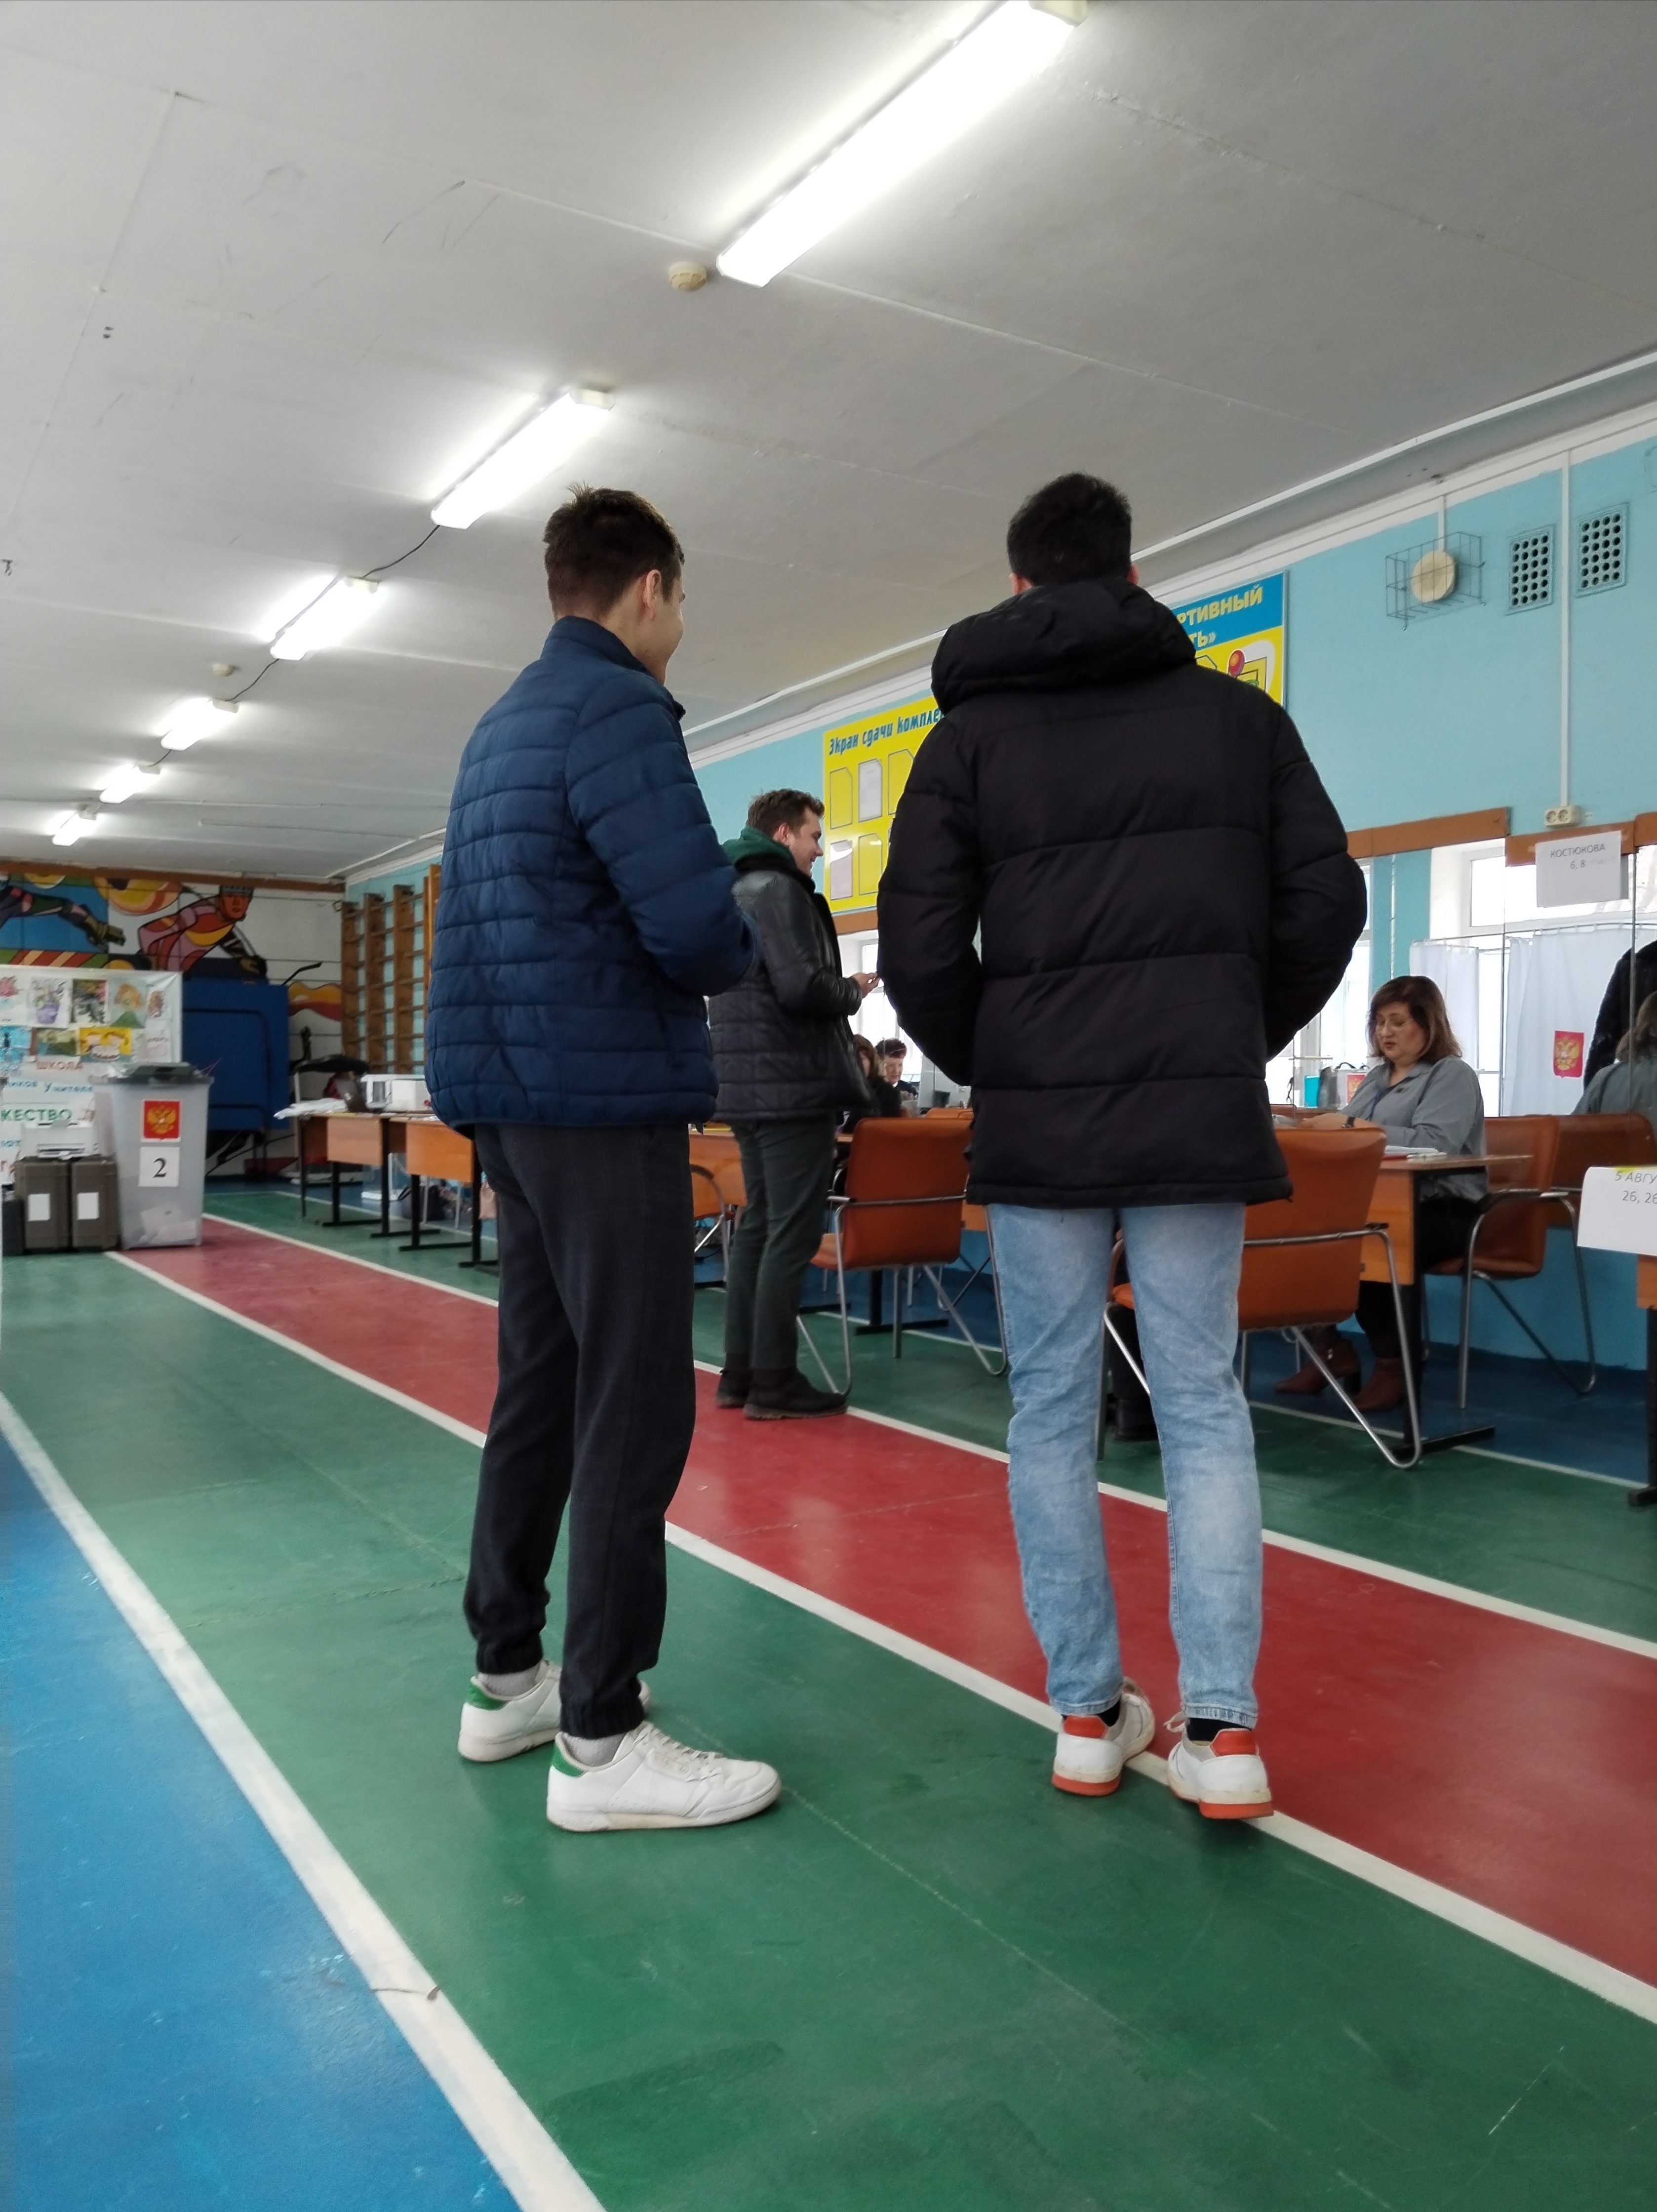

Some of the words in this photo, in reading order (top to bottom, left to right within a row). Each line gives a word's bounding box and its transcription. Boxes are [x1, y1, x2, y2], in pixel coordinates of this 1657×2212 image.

[829, 734, 859, 756] Экран
[862, 723, 894, 747] сдачи
[1550, 844, 1605, 858] КОСТЮКОВА
[1570, 861, 1578, 870] 6,
[152, 1158, 167, 1178] 2
[1615, 1171, 1622, 1181] 5
[1624, 1172, 1657, 1184] АВГУ
[1622, 1190, 1640, 1204] 26,
